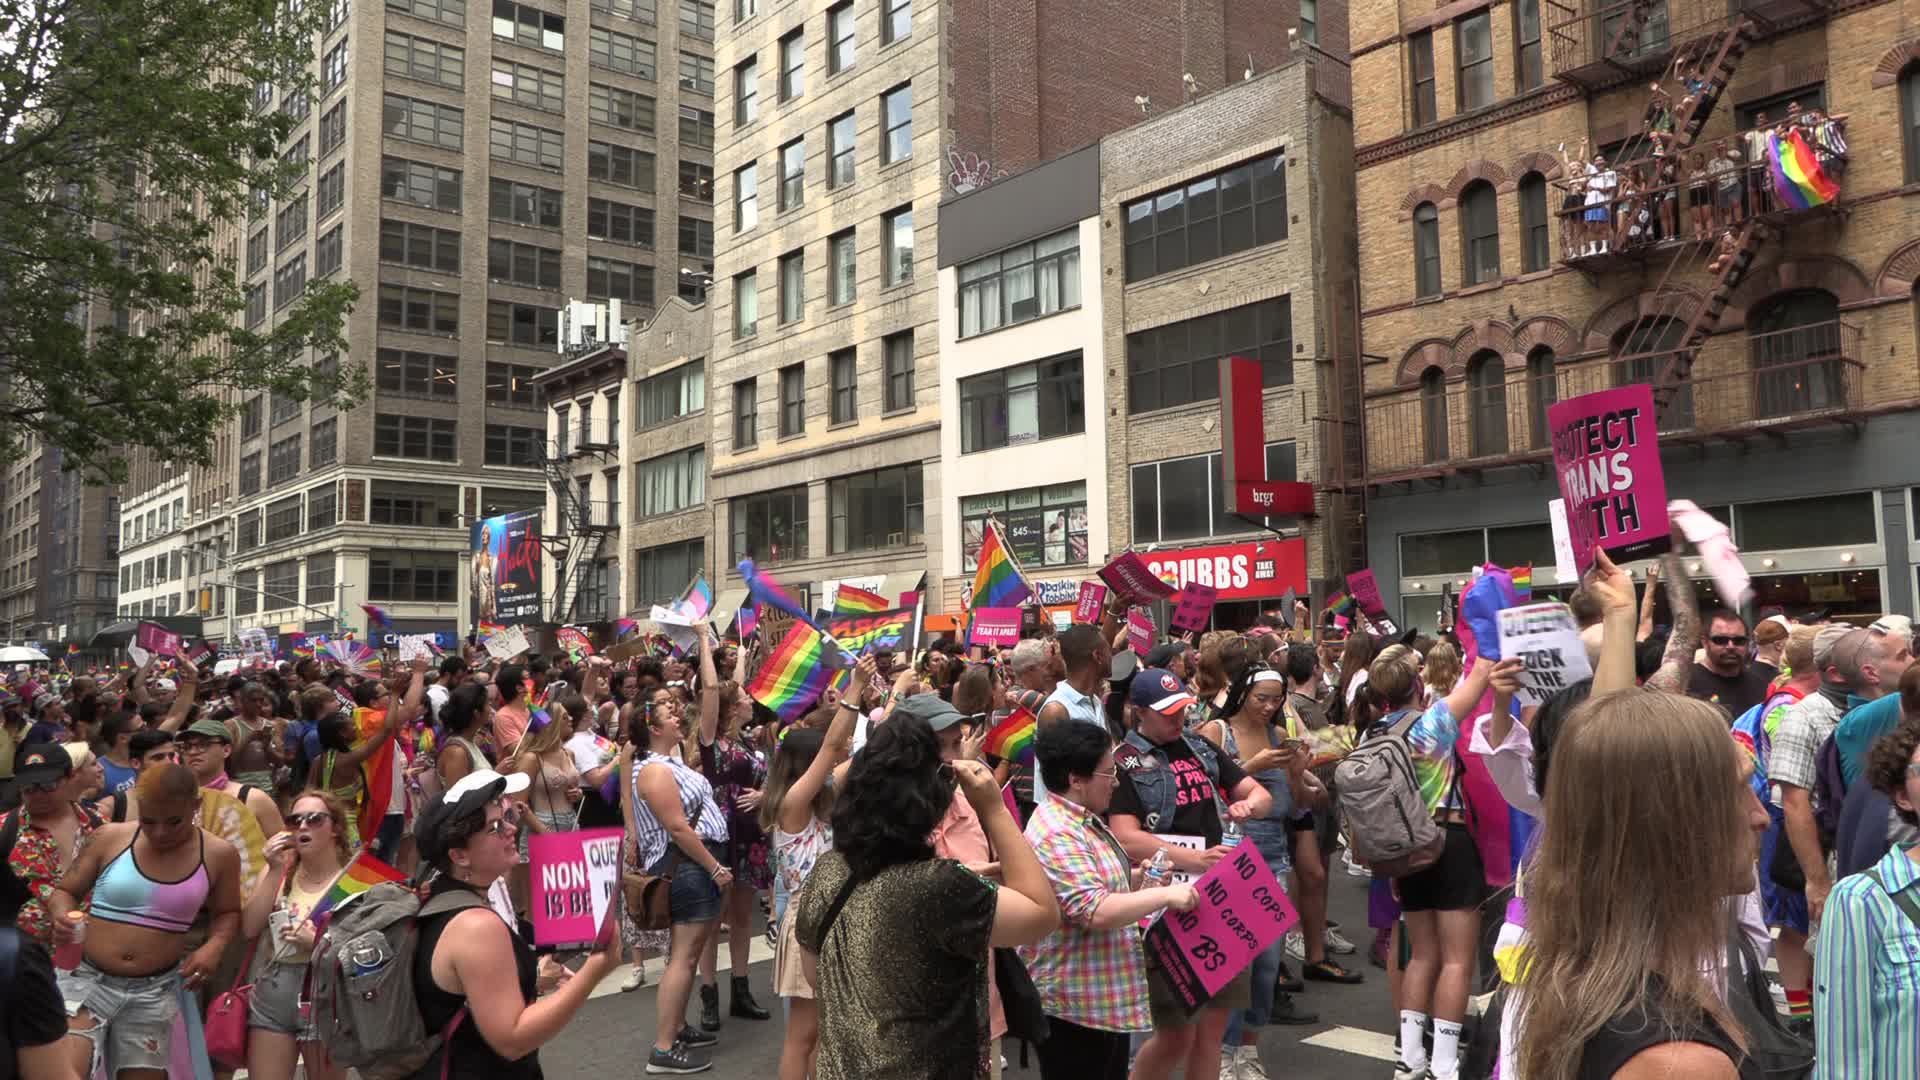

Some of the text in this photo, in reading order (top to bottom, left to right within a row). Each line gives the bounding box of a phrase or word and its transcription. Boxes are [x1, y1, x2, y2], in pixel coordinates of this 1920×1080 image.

[1564, 451, 1634, 512] TRANS
[1252, 488, 1274, 506] brgr
[1013, 526, 1028, 537] $45
[1255, 560, 1273, 570] TAKE
[1255, 569, 1275, 579] AWAY
[1045, 579, 1076, 592] baskin
[1045, 591, 1076, 603] robbins
[999, 627, 1017, 637] APART
[1529, 671, 1566, 687] THE
[1191, 788, 1201, 802] A
[590, 840, 620, 869] QUE
[1232, 852, 1286, 922] NO COPS
[546, 892, 565, 920] IS
[1204, 877, 1258, 950] NO CORPS
[1175, 909, 1199, 933] NO
[1191, 935, 1227, 972] BS
